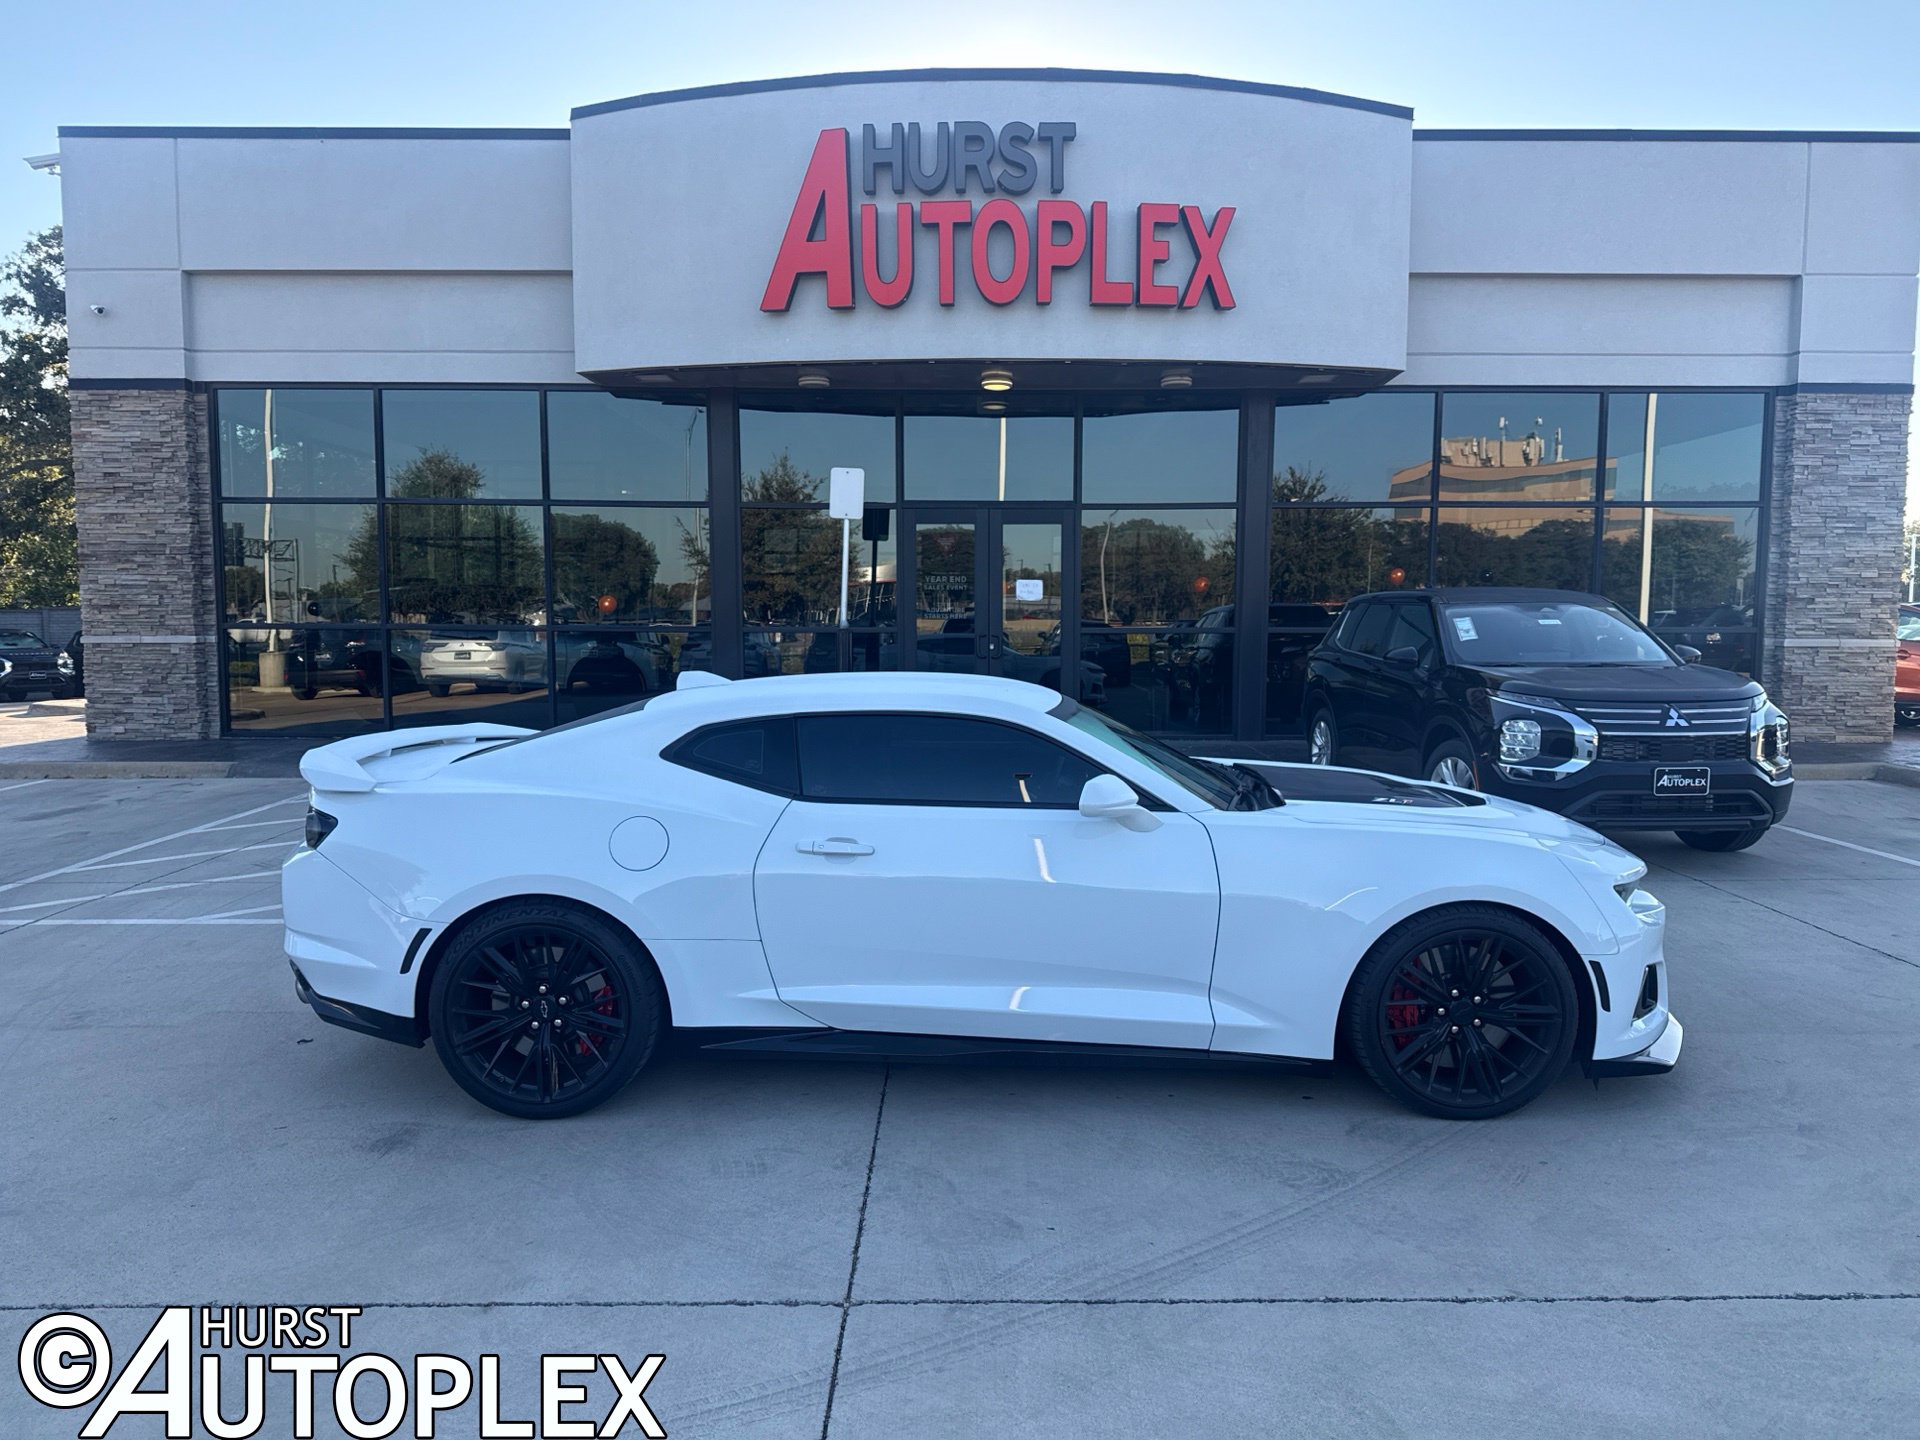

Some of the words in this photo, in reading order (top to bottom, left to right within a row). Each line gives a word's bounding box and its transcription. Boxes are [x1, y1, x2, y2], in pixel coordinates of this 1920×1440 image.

[862, 121, 1077, 195] HURST
[760, 127, 1237, 312] AUTOPLEX
[925, 575, 948, 583] YEAR
[949, 575, 967, 583] END
[1657, 774, 1706, 787] AUTOPLEX
